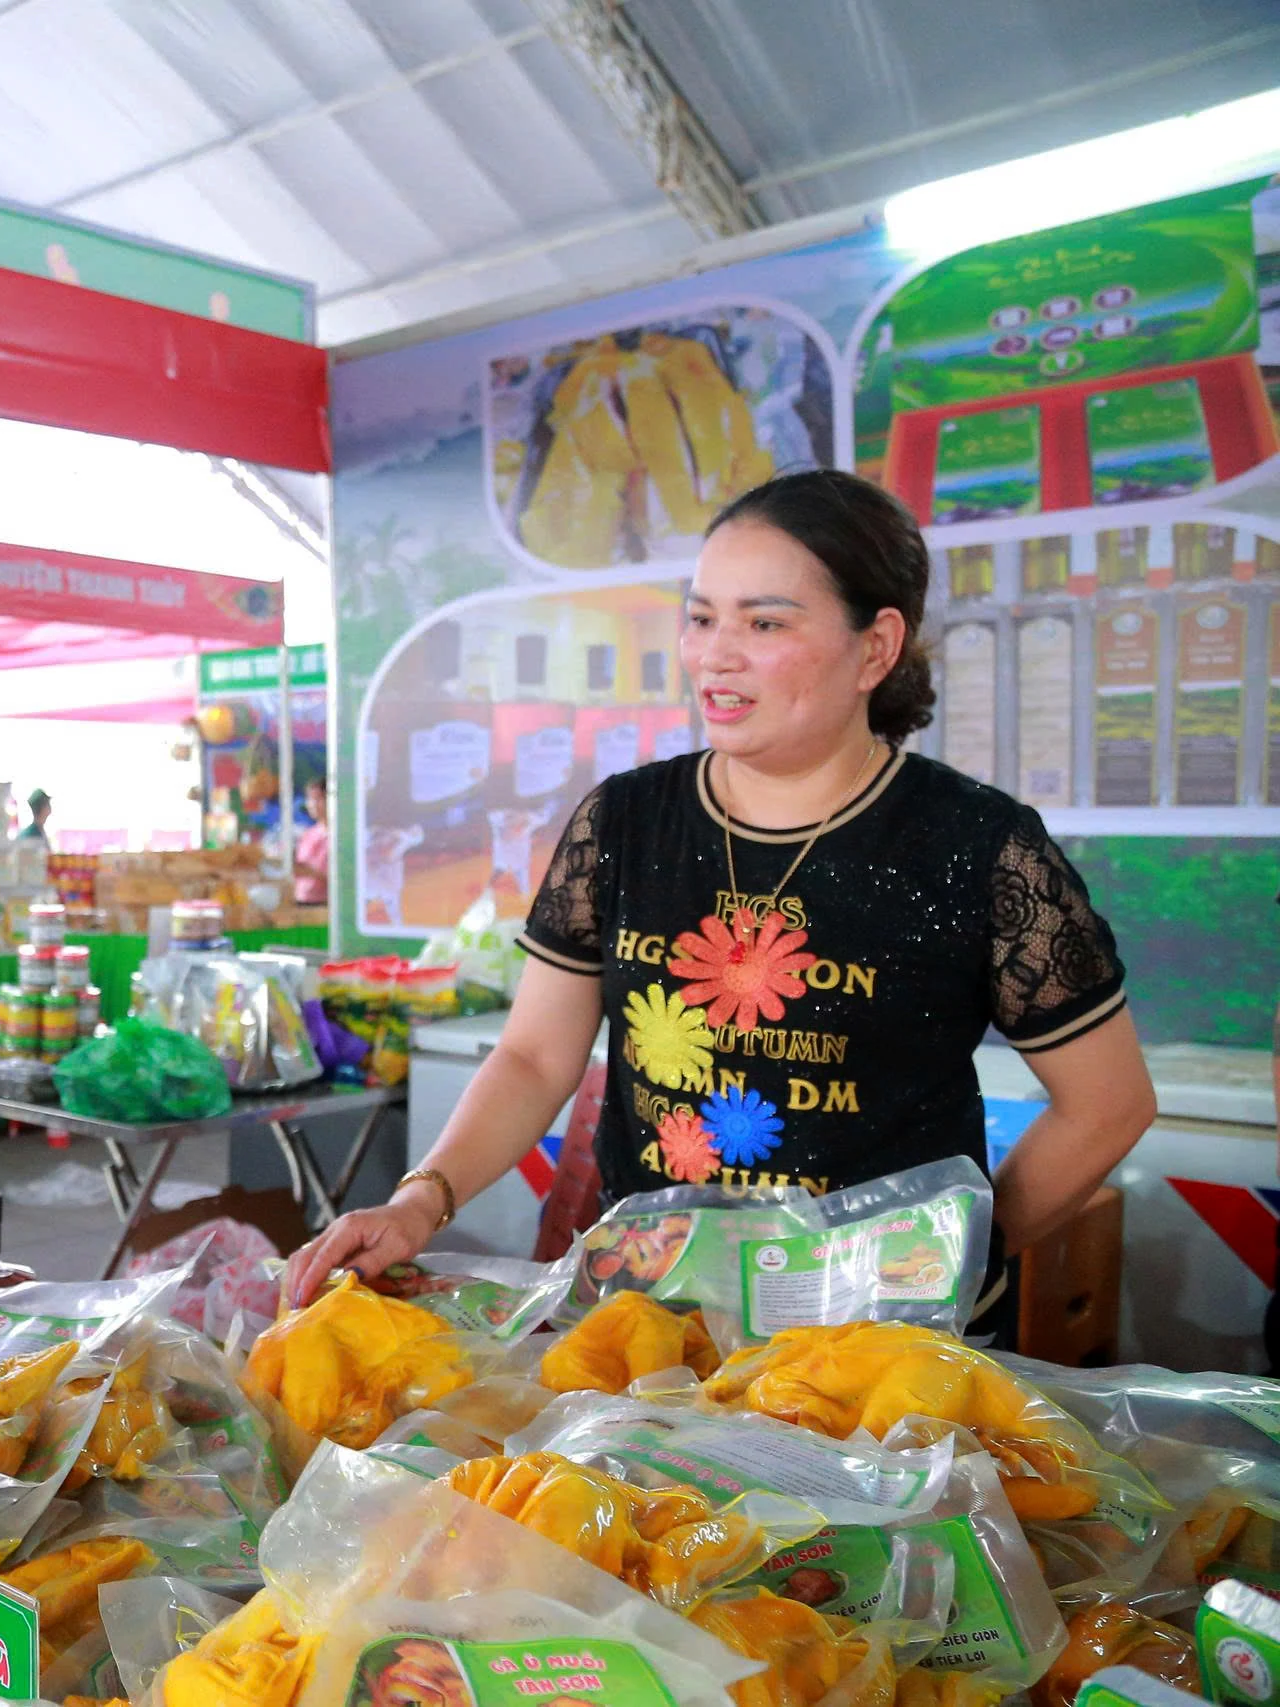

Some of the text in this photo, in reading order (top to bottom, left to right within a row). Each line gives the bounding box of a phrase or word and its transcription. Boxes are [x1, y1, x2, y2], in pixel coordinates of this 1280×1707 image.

[716, 890, 807, 931] HGS
[786, 1077, 861, 1113] DM
[798, 1543, 833, 1562] SƠN
[489, 1656, 519, 1674] GÀ
[546, 1651, 608, 1672] MUỐI
[514, 1674, 604, 1696] TÂN SƠN
